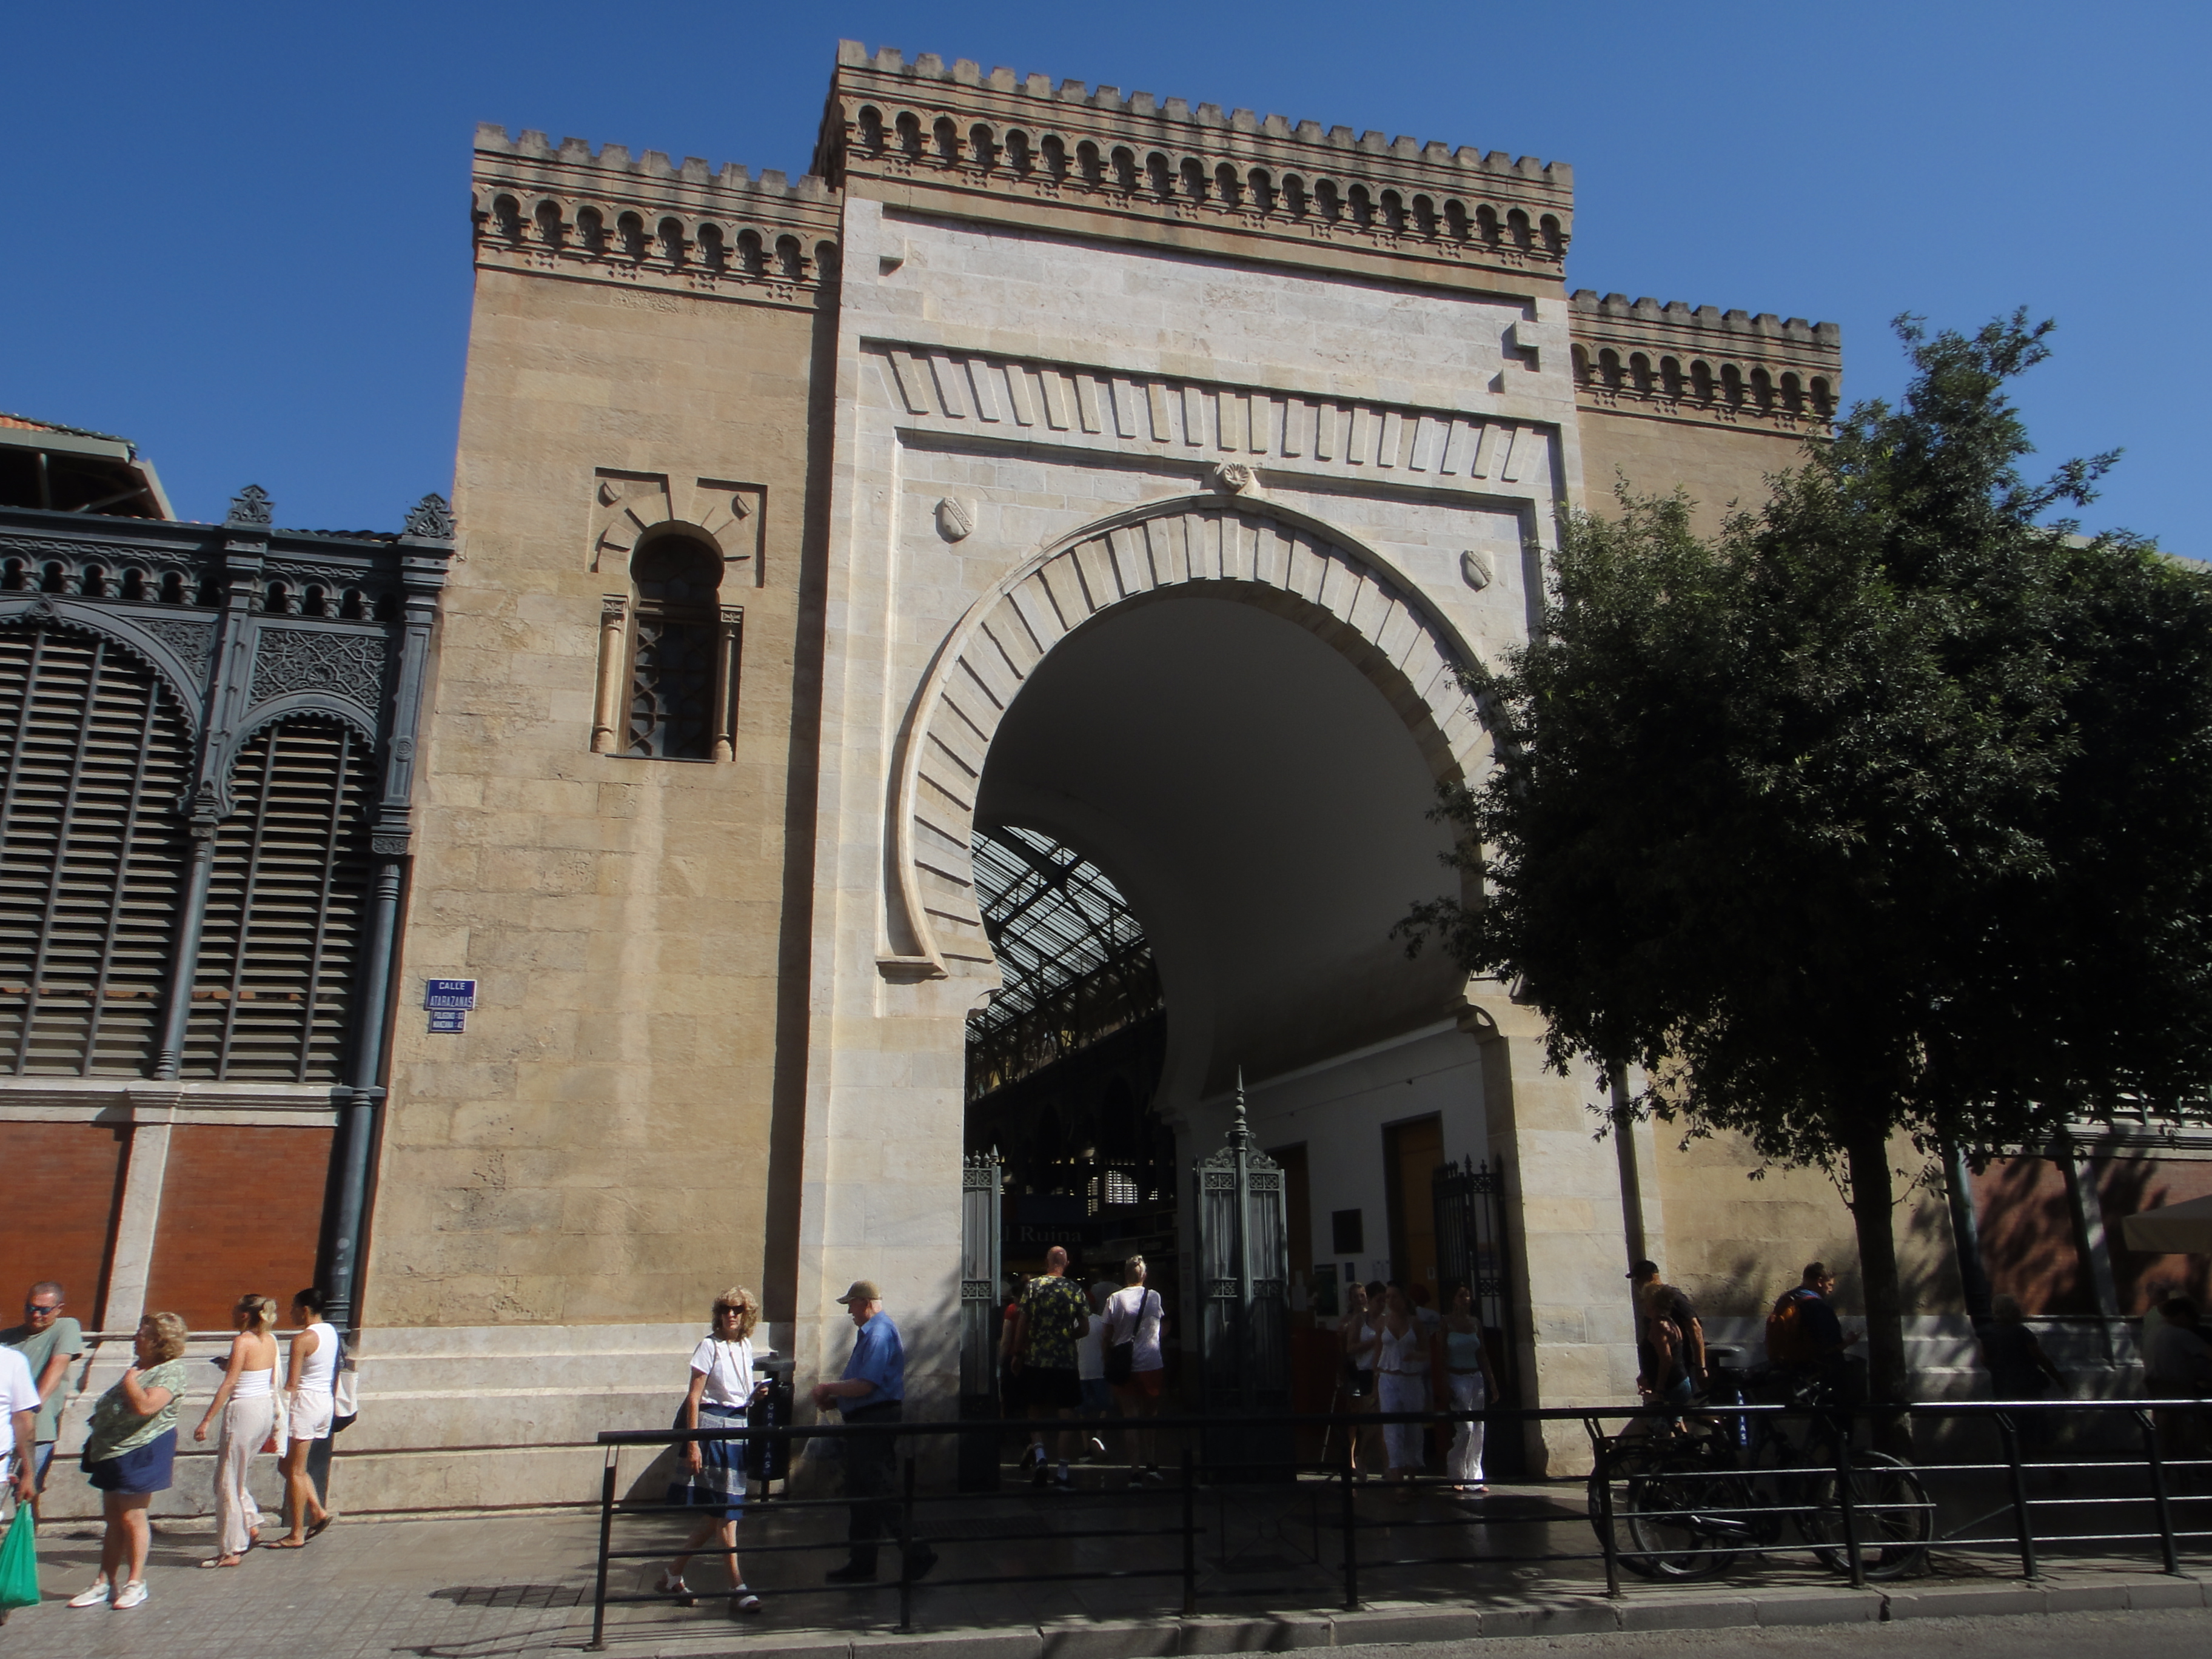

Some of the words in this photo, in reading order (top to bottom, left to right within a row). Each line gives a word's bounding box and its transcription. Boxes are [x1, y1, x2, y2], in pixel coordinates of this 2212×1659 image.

[430, 996, 473, 1007] ATARAZANAS
[1019, 1225, 1082, 1242] Ruina
[764, 1403, 774, 1469] GRAIAS
